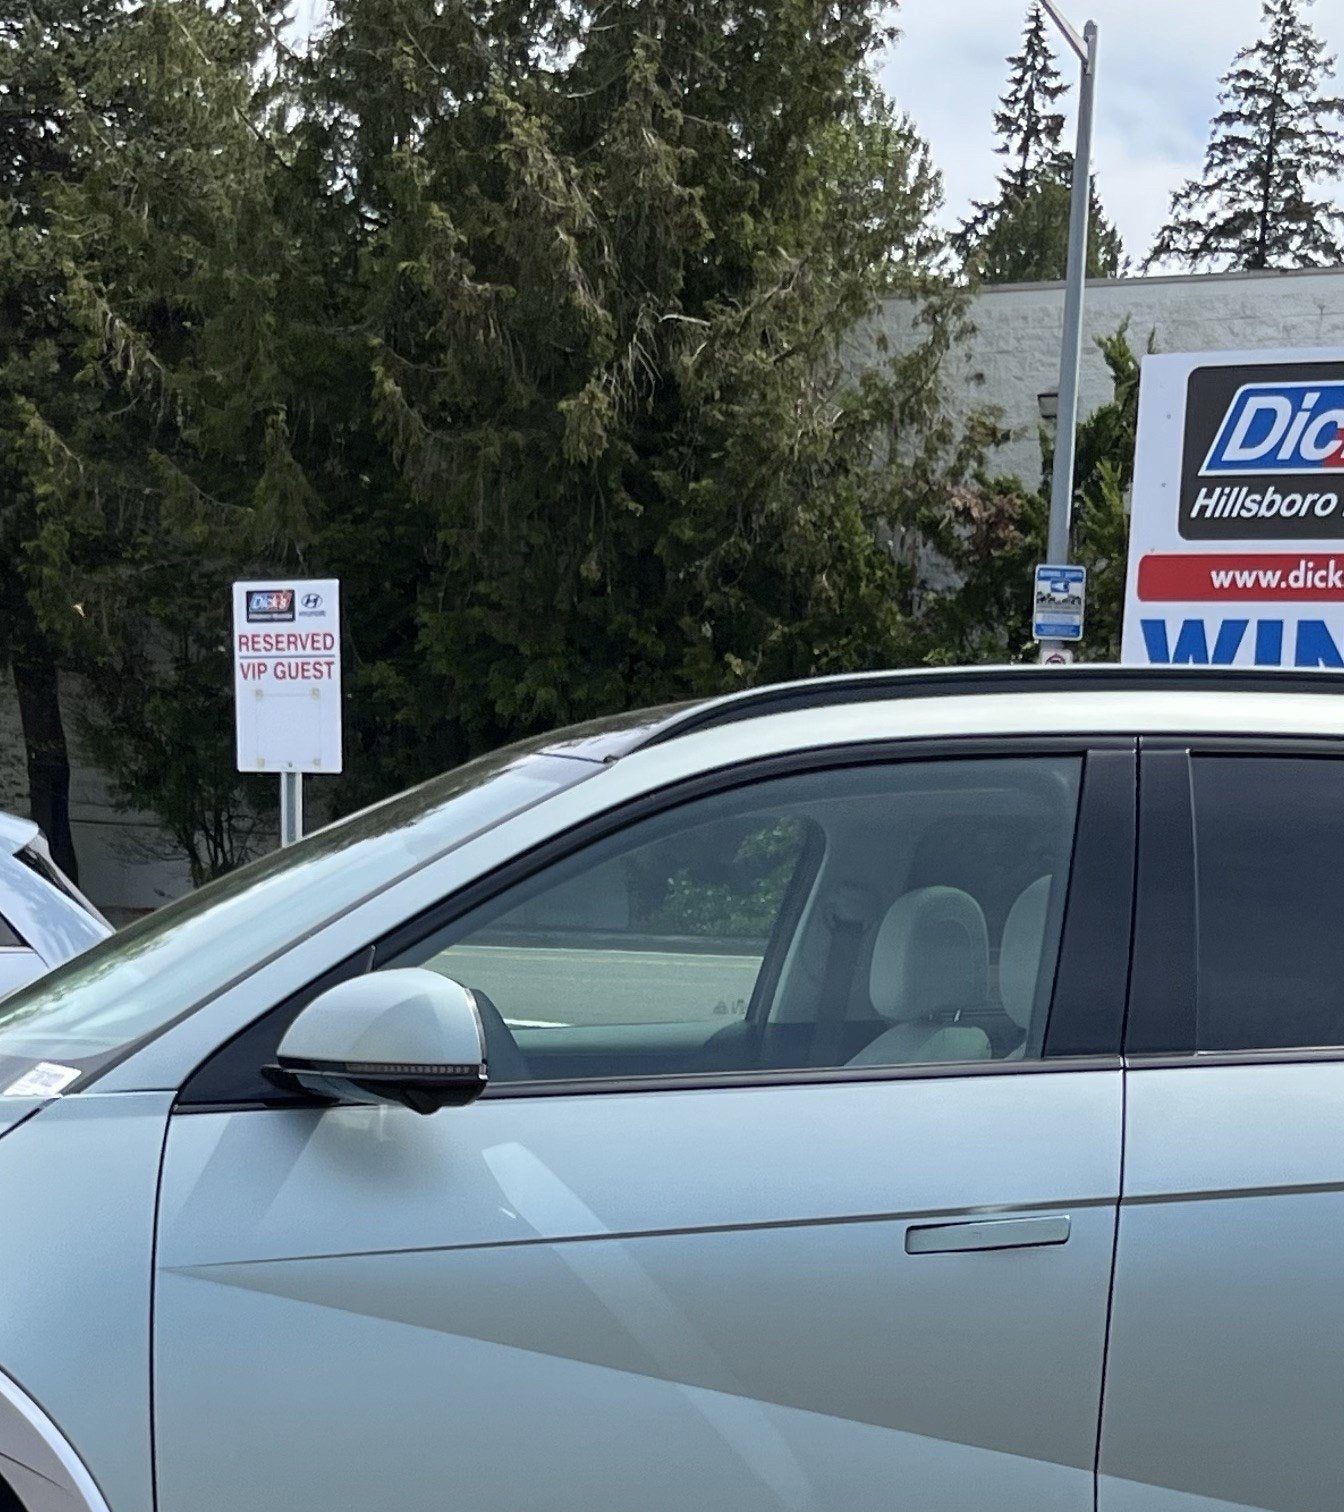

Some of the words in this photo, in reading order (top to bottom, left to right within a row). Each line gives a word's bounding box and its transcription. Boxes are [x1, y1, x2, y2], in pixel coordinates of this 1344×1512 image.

[1189, 486, 1339, 519] Hillsboro
[238, 632, 335, 652] RESERVED
[239, 662, 268, 681] VIP
[273, 661, 335, 681] GUEST
